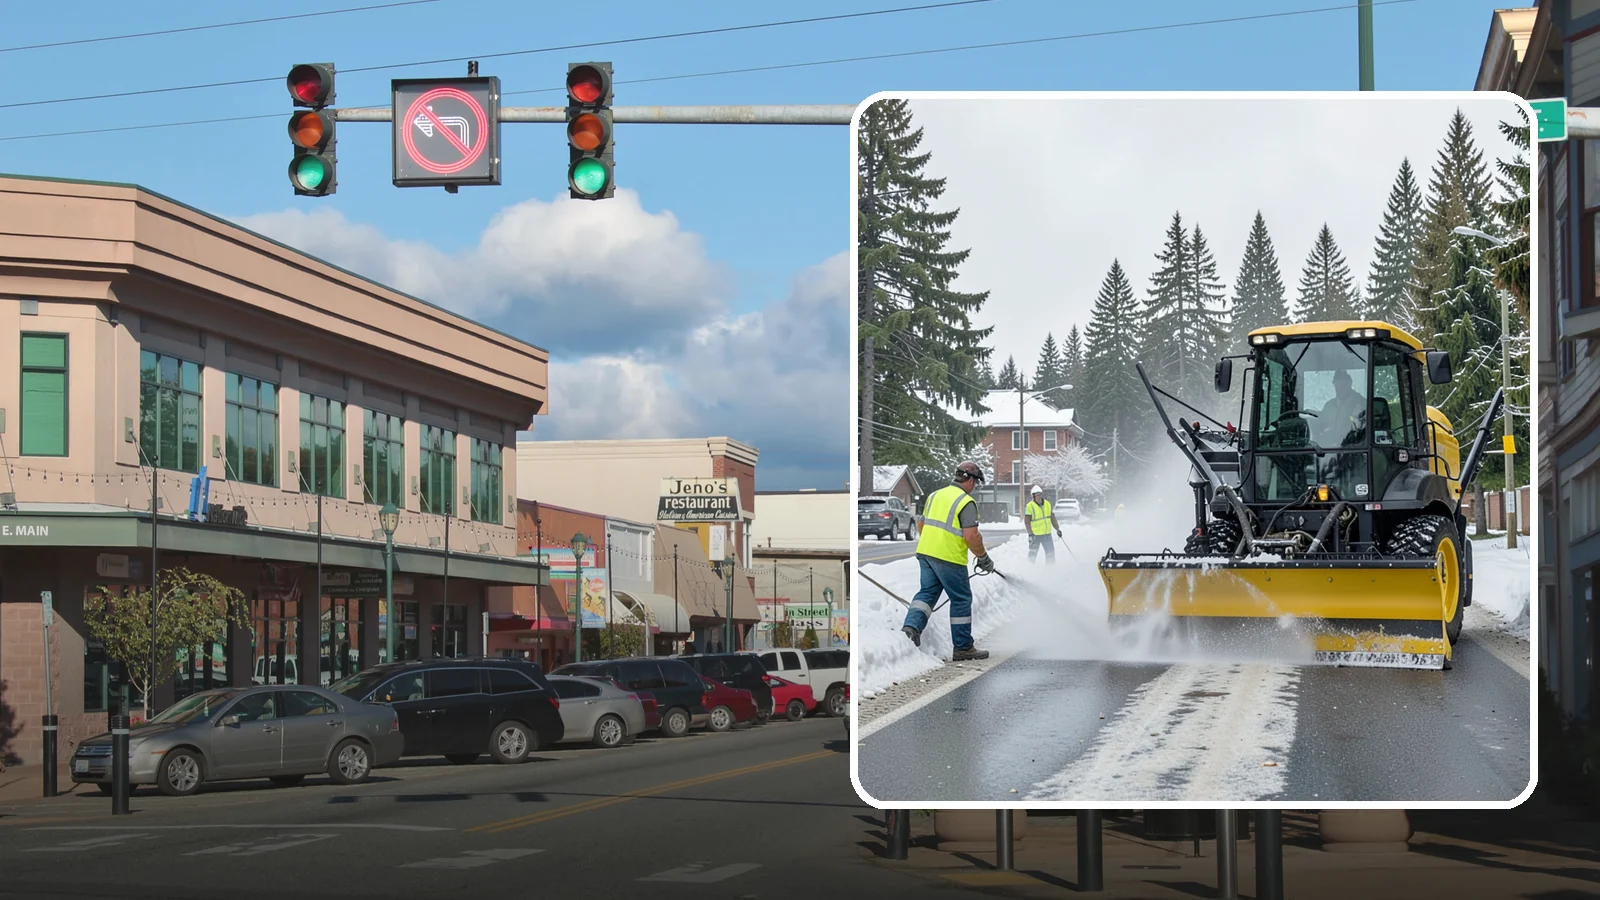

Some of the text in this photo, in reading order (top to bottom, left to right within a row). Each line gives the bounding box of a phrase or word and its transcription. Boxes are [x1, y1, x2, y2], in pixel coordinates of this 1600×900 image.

[670, 480, 727, 494] Jeno's
[665, 496, 731, 509] restaurant
[658, 509, 681, 519] Italian
[686, 509, 714, 519] American
[715, 509, 737, 519] Cuisine
[2, 525, 49, 536] E. MAIN
[797, 607, 828, 616] Street
[790, 619, 823, 627] lass
